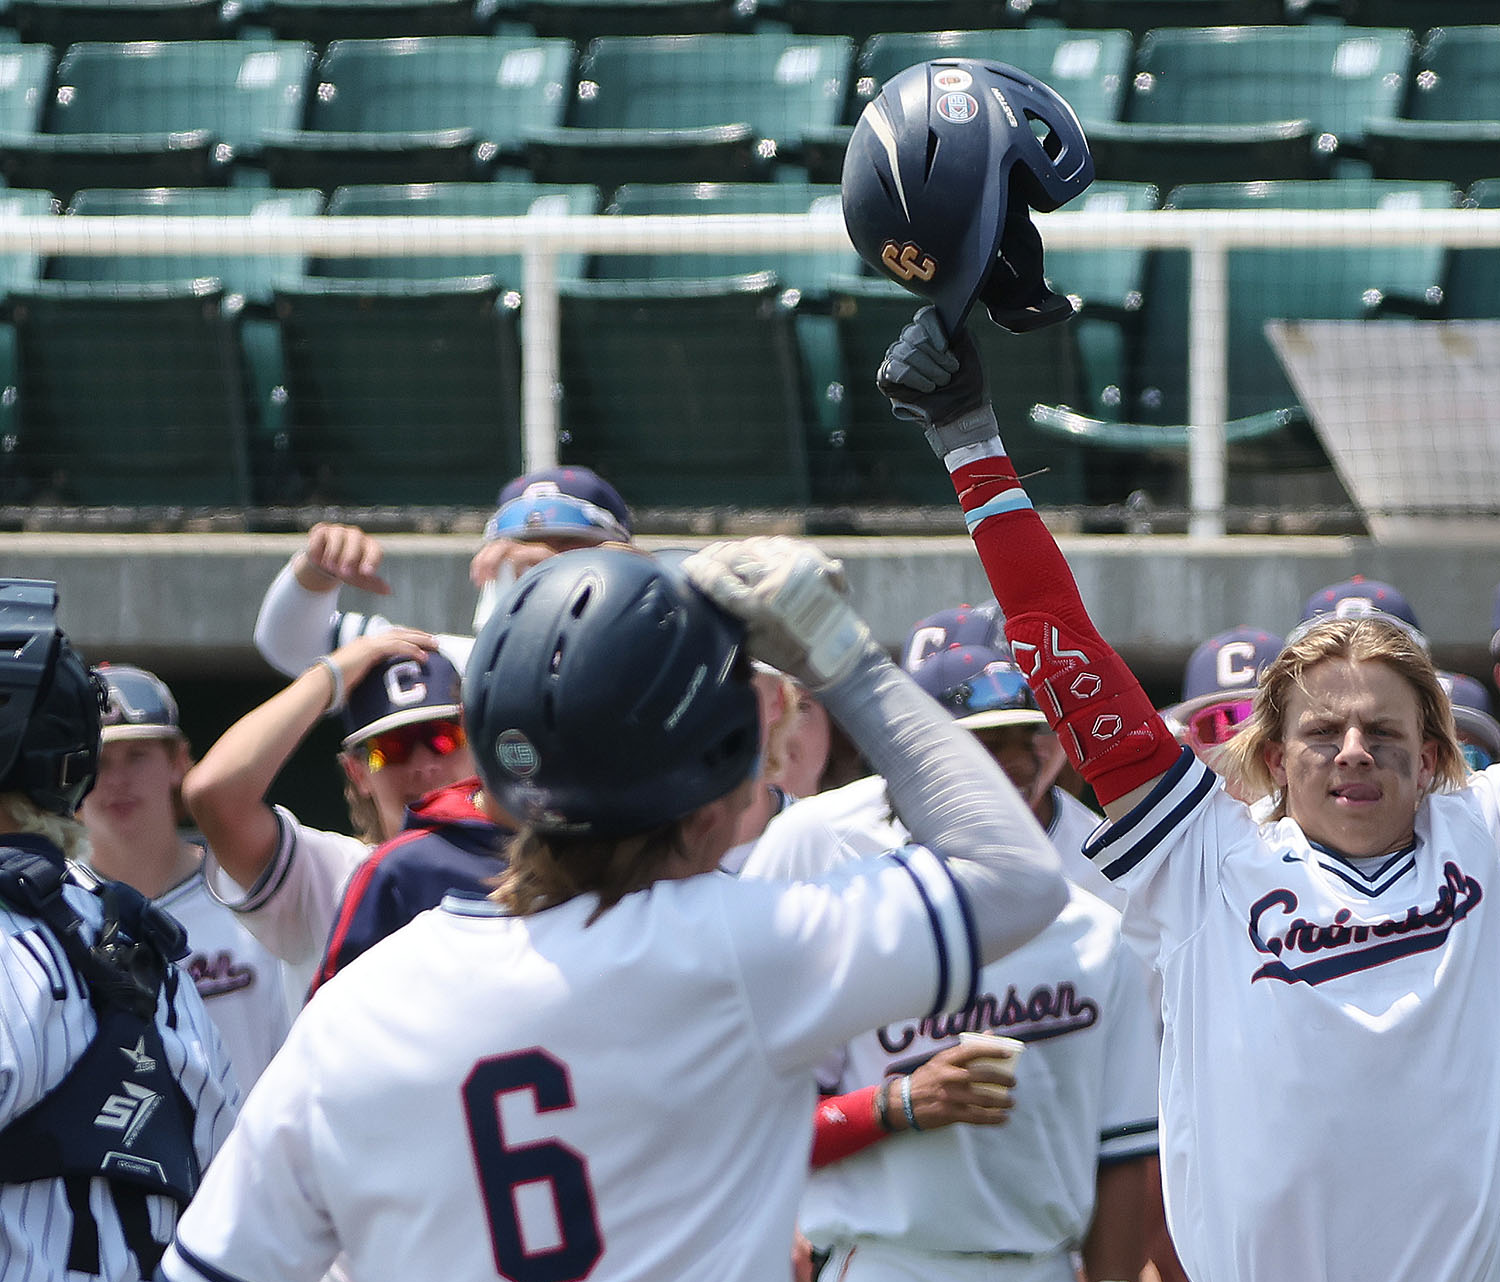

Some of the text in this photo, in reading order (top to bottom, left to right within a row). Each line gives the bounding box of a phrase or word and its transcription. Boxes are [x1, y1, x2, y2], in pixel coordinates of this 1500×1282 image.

[990, 87, 1018, 128] EASTON
[384, 660, 427, 707] C
[1216, 641, 1256, 688] C
